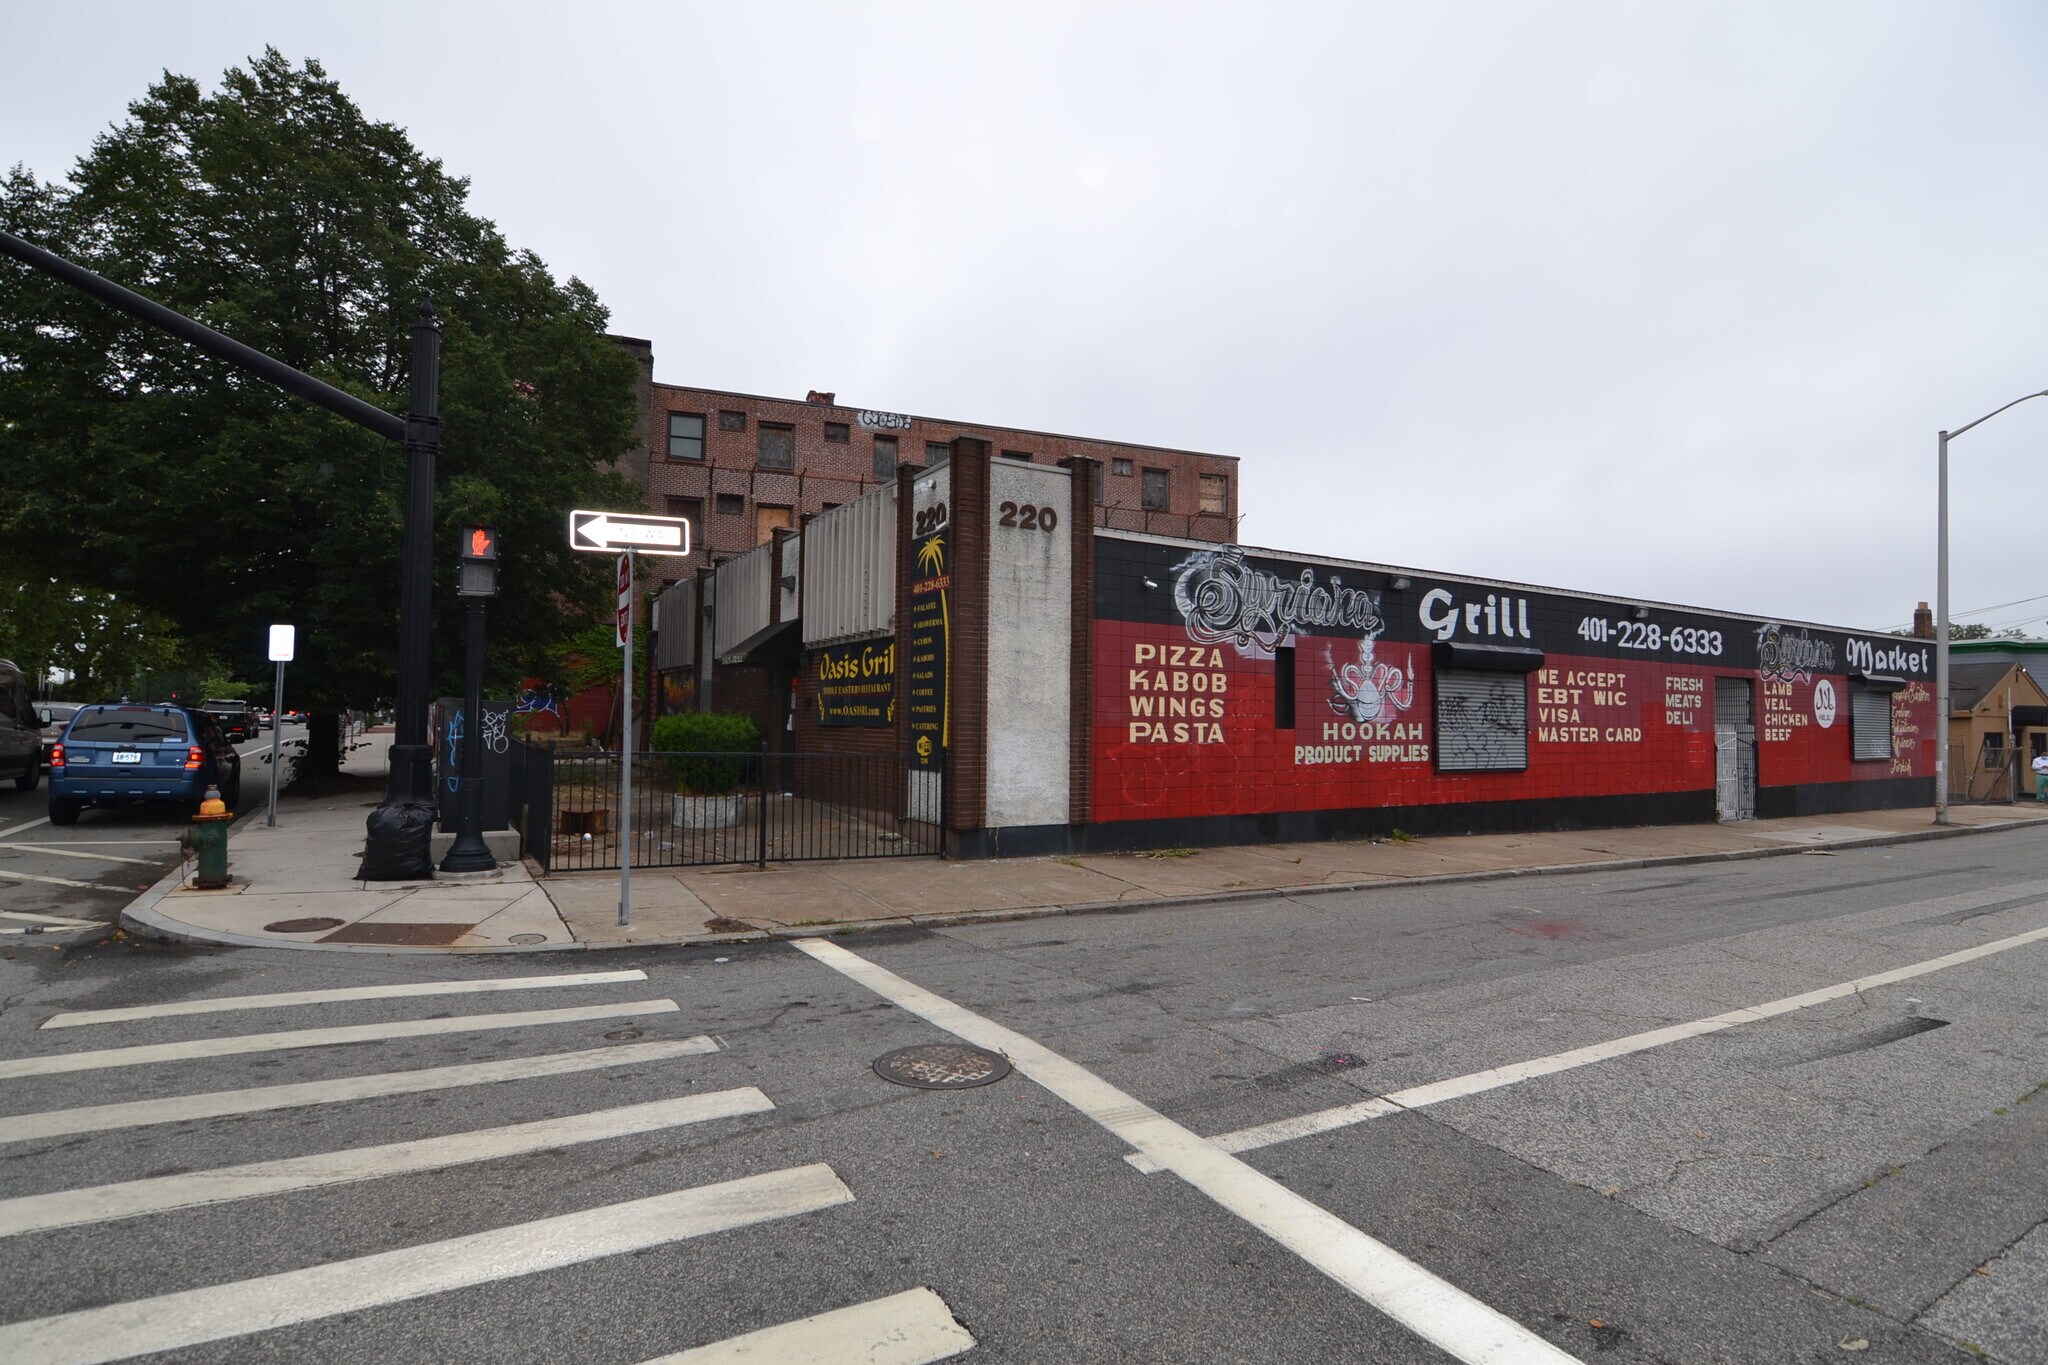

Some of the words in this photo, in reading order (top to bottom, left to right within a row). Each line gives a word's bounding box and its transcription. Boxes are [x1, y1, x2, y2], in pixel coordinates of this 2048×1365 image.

[916, 502, 947, 536] 220
[999, 500, 1058, 532] 220
[913, 576, 950, 595] 401-228-6333
[1419, 588, 1531, 640] Grill
[1578, 617, 1723, 656] 401-228-6333
[820, 653, 859, 680] Oasis
[862, 643, 895, 677] Gril
[1135, 643, 1224, 668] PIZZA
[1846, 638, 1928, 675] Market
[1129, 669, 1227, 693] KABOB
[1538, 669, 1559, 685] WE
[1567, 671, 1626, 688] ACCEPT
[1665, 677, 1703, 692] FRESH
[1538, 688, 1583, 705] EBT
[1594, 690, 1627, 706] WIC
[1764, 683, 1792, 696] LAMB
[1129, 696, 1225, 718] WINGS
[1665, 694, 1702, 708] MEATS
[1764, 698, 1792, 711] VEAL
[1538, 708, 1581, 723] VISA
[1666, 711, 1693, 725] DELI
[1765, 714, 1808, 726] CHICKEN
[1129, 722, 1225, 743] PASTA
[1323, 722, 1423, 740] HOOKAH
[1538, 727, 1599, 743] MASTER
[1605, 728, 1642, 743] CARD
[1765, 729, 1792, 741] BEEF
[1294, 745, 1362, 765] PRODUCT
[1368, 745, 1429, 762] SUPPLIES
